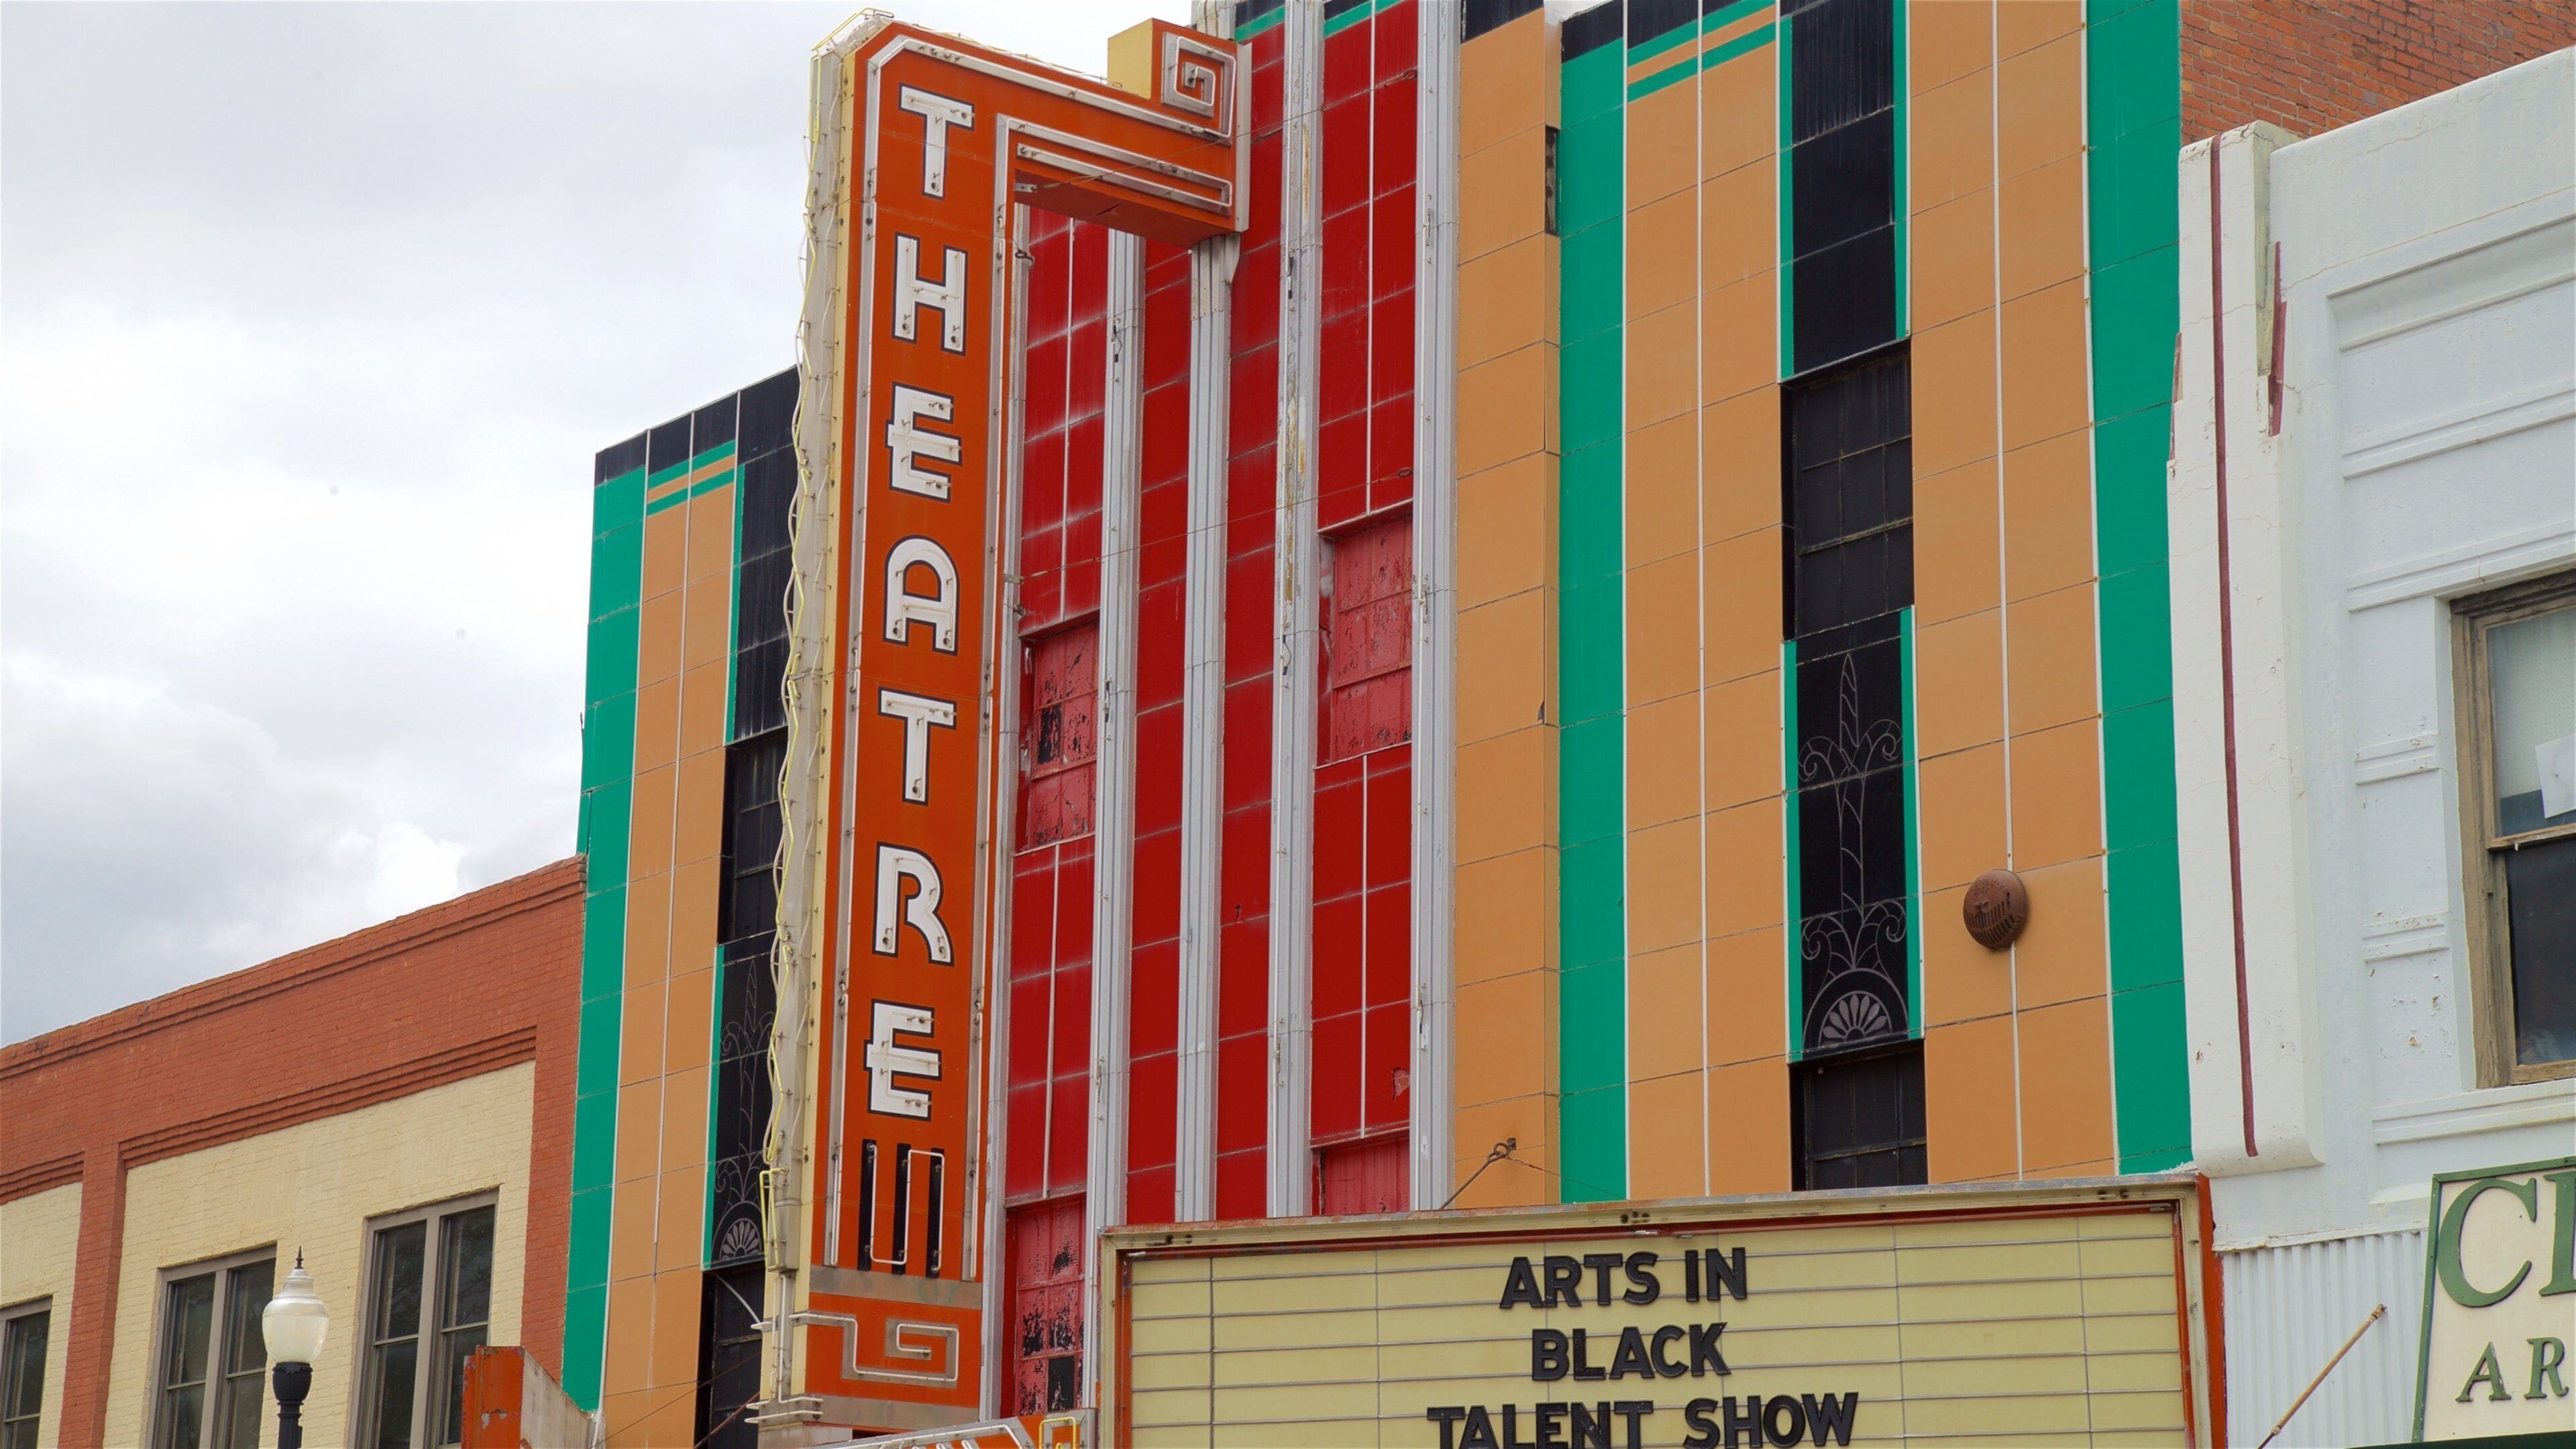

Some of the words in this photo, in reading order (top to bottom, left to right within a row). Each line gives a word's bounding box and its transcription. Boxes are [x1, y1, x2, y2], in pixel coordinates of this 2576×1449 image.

[863, 82, 975, 1122] THEATRE
[1499, 1251, 1660, 1309] ARTS
[1684, 1247, 1747, 1302] IN
[1532, 1322, 1731, 1381] BLACK
[2456, 1337, 2569, 1401] AR
[1427, 1400, 1653, 1449] TALENT
[1683, 1392, 1859, 1449] SHOW
